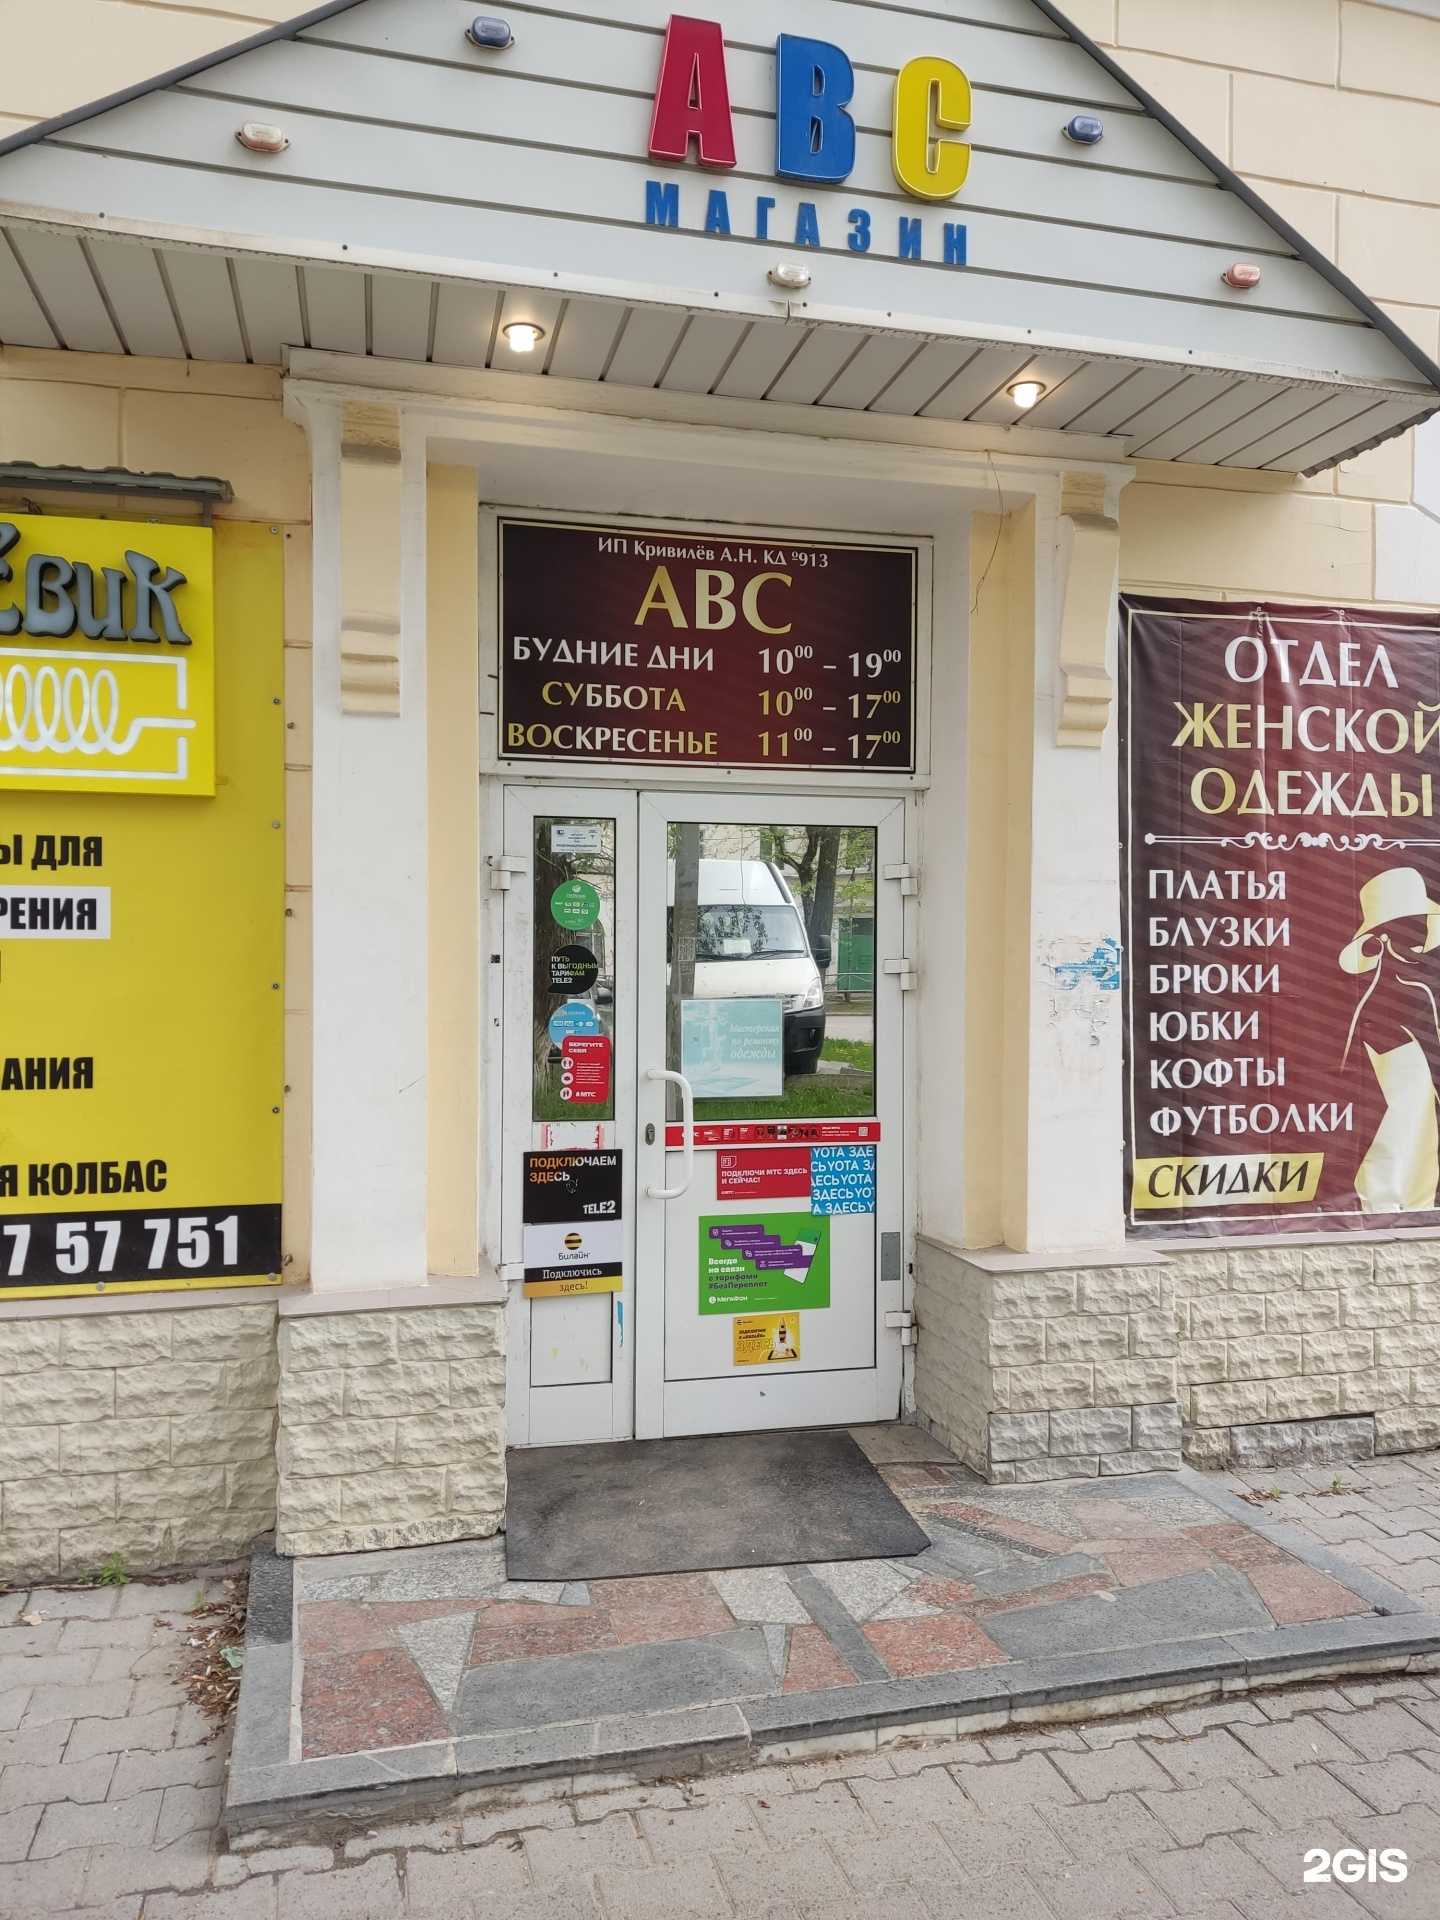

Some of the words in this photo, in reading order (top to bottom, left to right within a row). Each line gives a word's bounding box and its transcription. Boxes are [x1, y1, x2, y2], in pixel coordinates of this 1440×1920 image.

[648, 14, 972, 201] ABC
[645, 180, 967, 266] МАГАЗИН
[599, 537, 627, 554] ИП
[634, 540, 715, 560] Кривилёв
[720, 547, 757, 564] А.Н.
[763, 550, 787, 566] КД
[634, 565, 792, 635] ABC
[513, 637, 638, 669] БУДНИЕ
[647, 647, 714, 671] ДНИ
[1224, 636, 1400, 688] ОТДЕЛ
[542, 681, 687, 712] СУББОТА
[508, 723, 718, 756] ВОСКРЕСЕНЬЕ
[1171, 700, 1440, 754] ЖЕНСКОЙ
[1190, 767, 1433, 818] ОДЕЖДЫ
[31, 834, 103, 871] ДЛЯ
[1149, 869, 1287, 900] ПЛАТЬЯ
[1149, 917, 1291, 947] БЛУЗКИ
[1149, 963, 1280, 994] БРЮКИ
[1149, 1010, 1260, 1042] ЮБКИ
[1, 1057, 94, 1090] АНИЯ
[1149, 1056, 1285, 1089] КОФТЫ
[1149, 1102, 1353, 1137] ФУТБОЛКИ
[529, 1155, 617, 1169] ПОДКЛЮЧАЕМ
[813, 1147, 845, 1158] YOTA
[827, 1160, 859, 1171] YOTA
[28, 1159, 167, 1196] КОЛБАС
[529, 1171, 571, 1184] ЗДЕСЬ
[721, 1169, 765, 1179] ПОДКЛЮЧИ
[766, 1168, 782, 1176] МТС
[783, 1167, 808, 1176] ЗДЕСЬ
[840, 1173, 872, 1185] YOTA
[1148, 1160, 1309, 1198] СКИДКИ
[583, 1200, 616, 1215] TELE2
[813, 1188, 854, 1201] ЗДЕСЬ
[825, 1201, 866, 1215] ЗДЕСЬ
[55, 1220, 122, 1275] 57
[144, 1215, 239, 1270] 751
[543, 1269, 602, 1280] Подключись
[559, 1281, 588, 1292] здесь!
